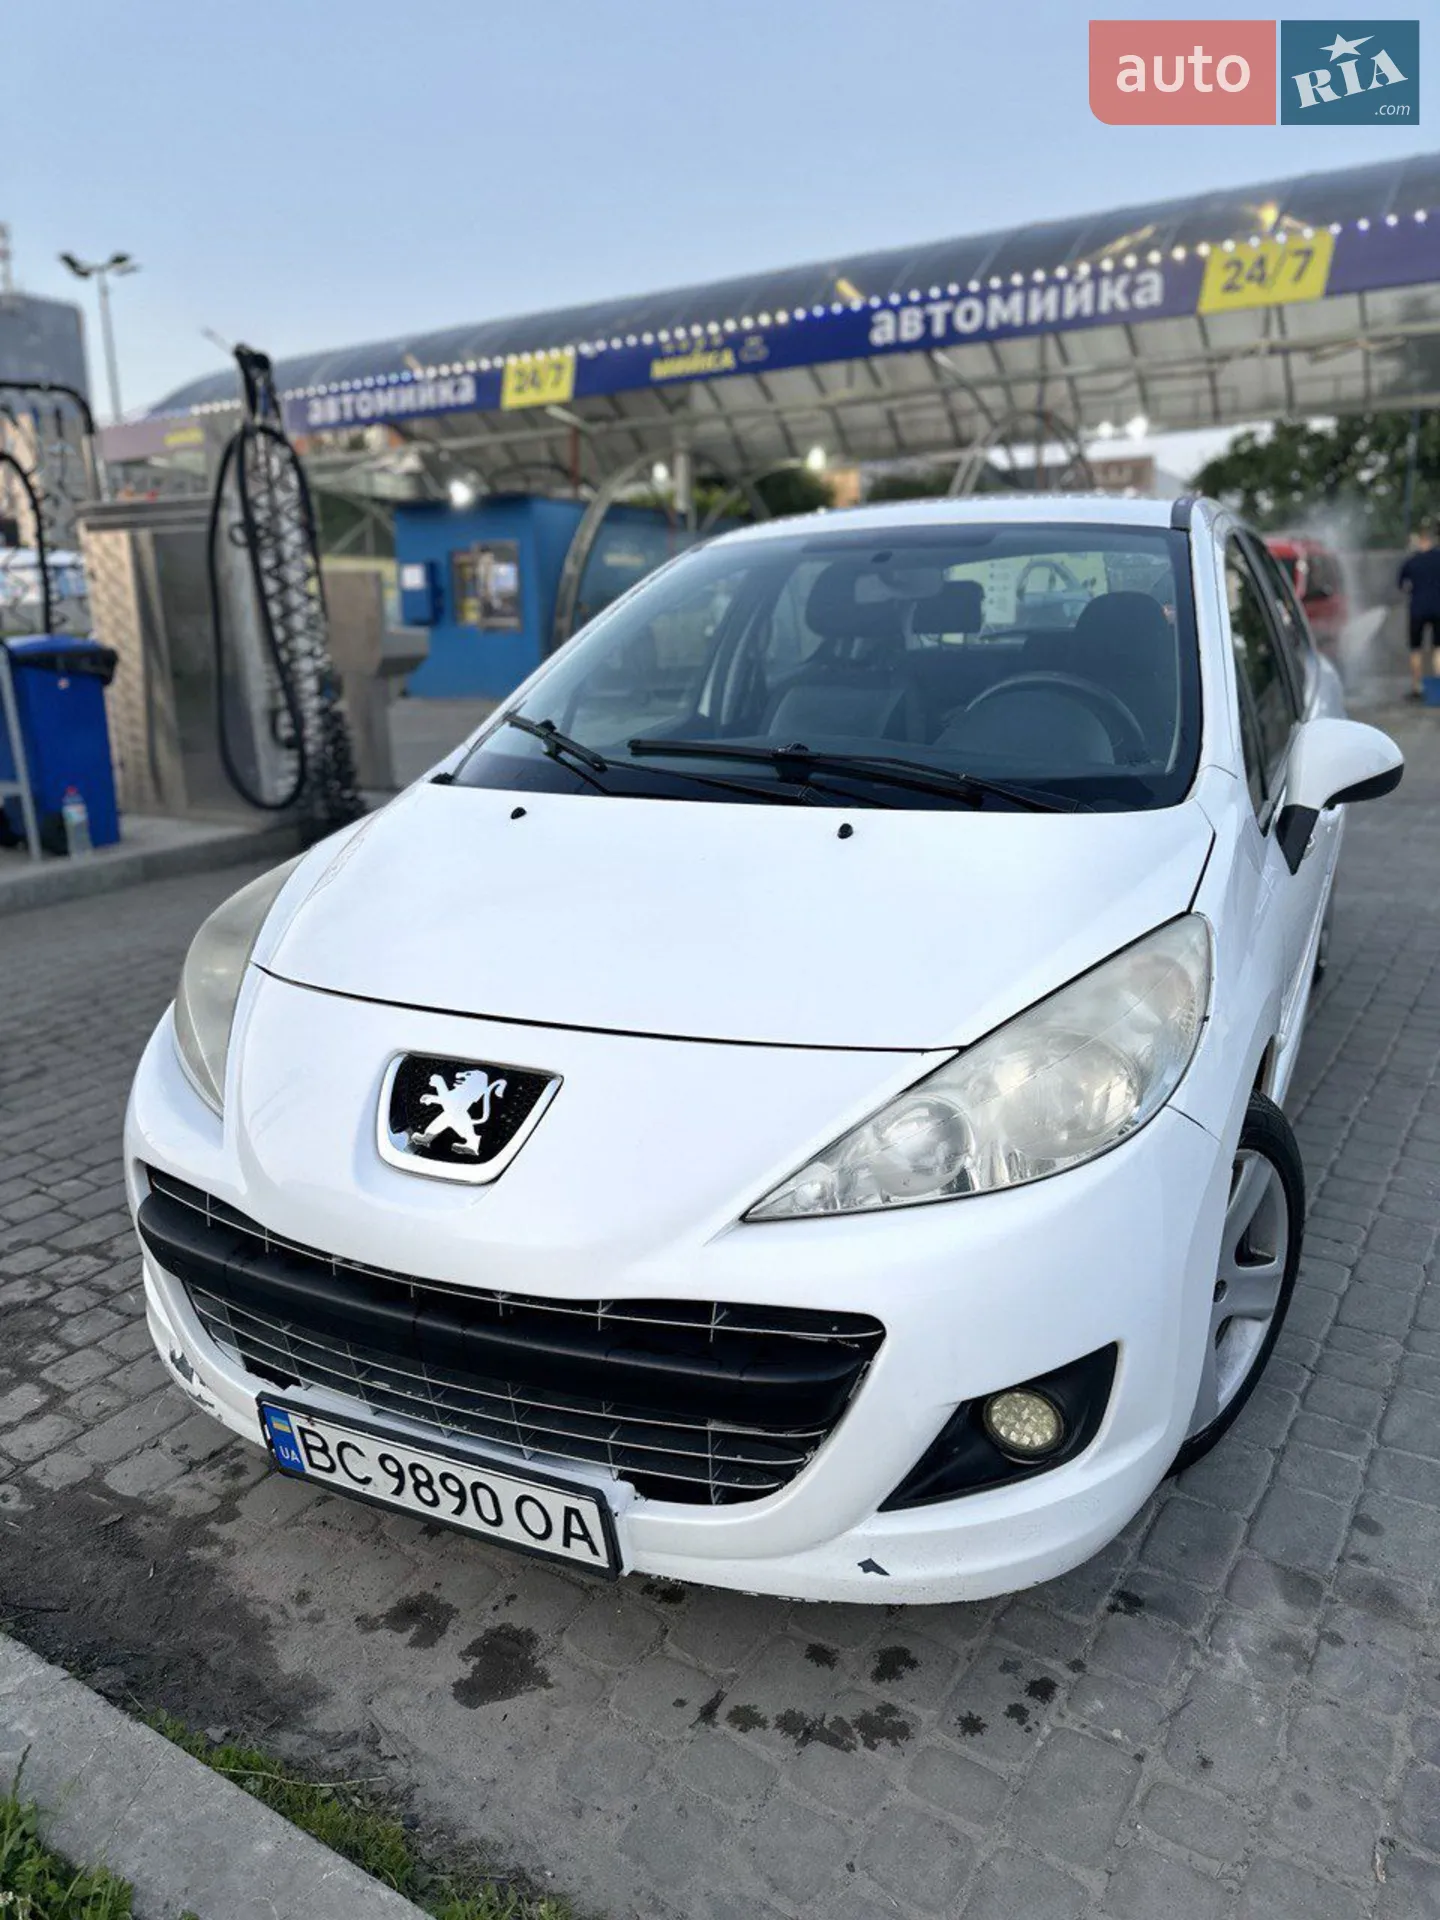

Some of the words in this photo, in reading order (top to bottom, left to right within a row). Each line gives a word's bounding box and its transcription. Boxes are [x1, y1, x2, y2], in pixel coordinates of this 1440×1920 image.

[868, 267, 1165, 348] автомийка
[1220, 248, 1315, 295] 24/7
[279, 1445, 301, 1465] UA
[297, 1424, 373, 1486] BC
[377, 1452, 504, 1528] 9890
[514, 1494, 600, 1557] OA
